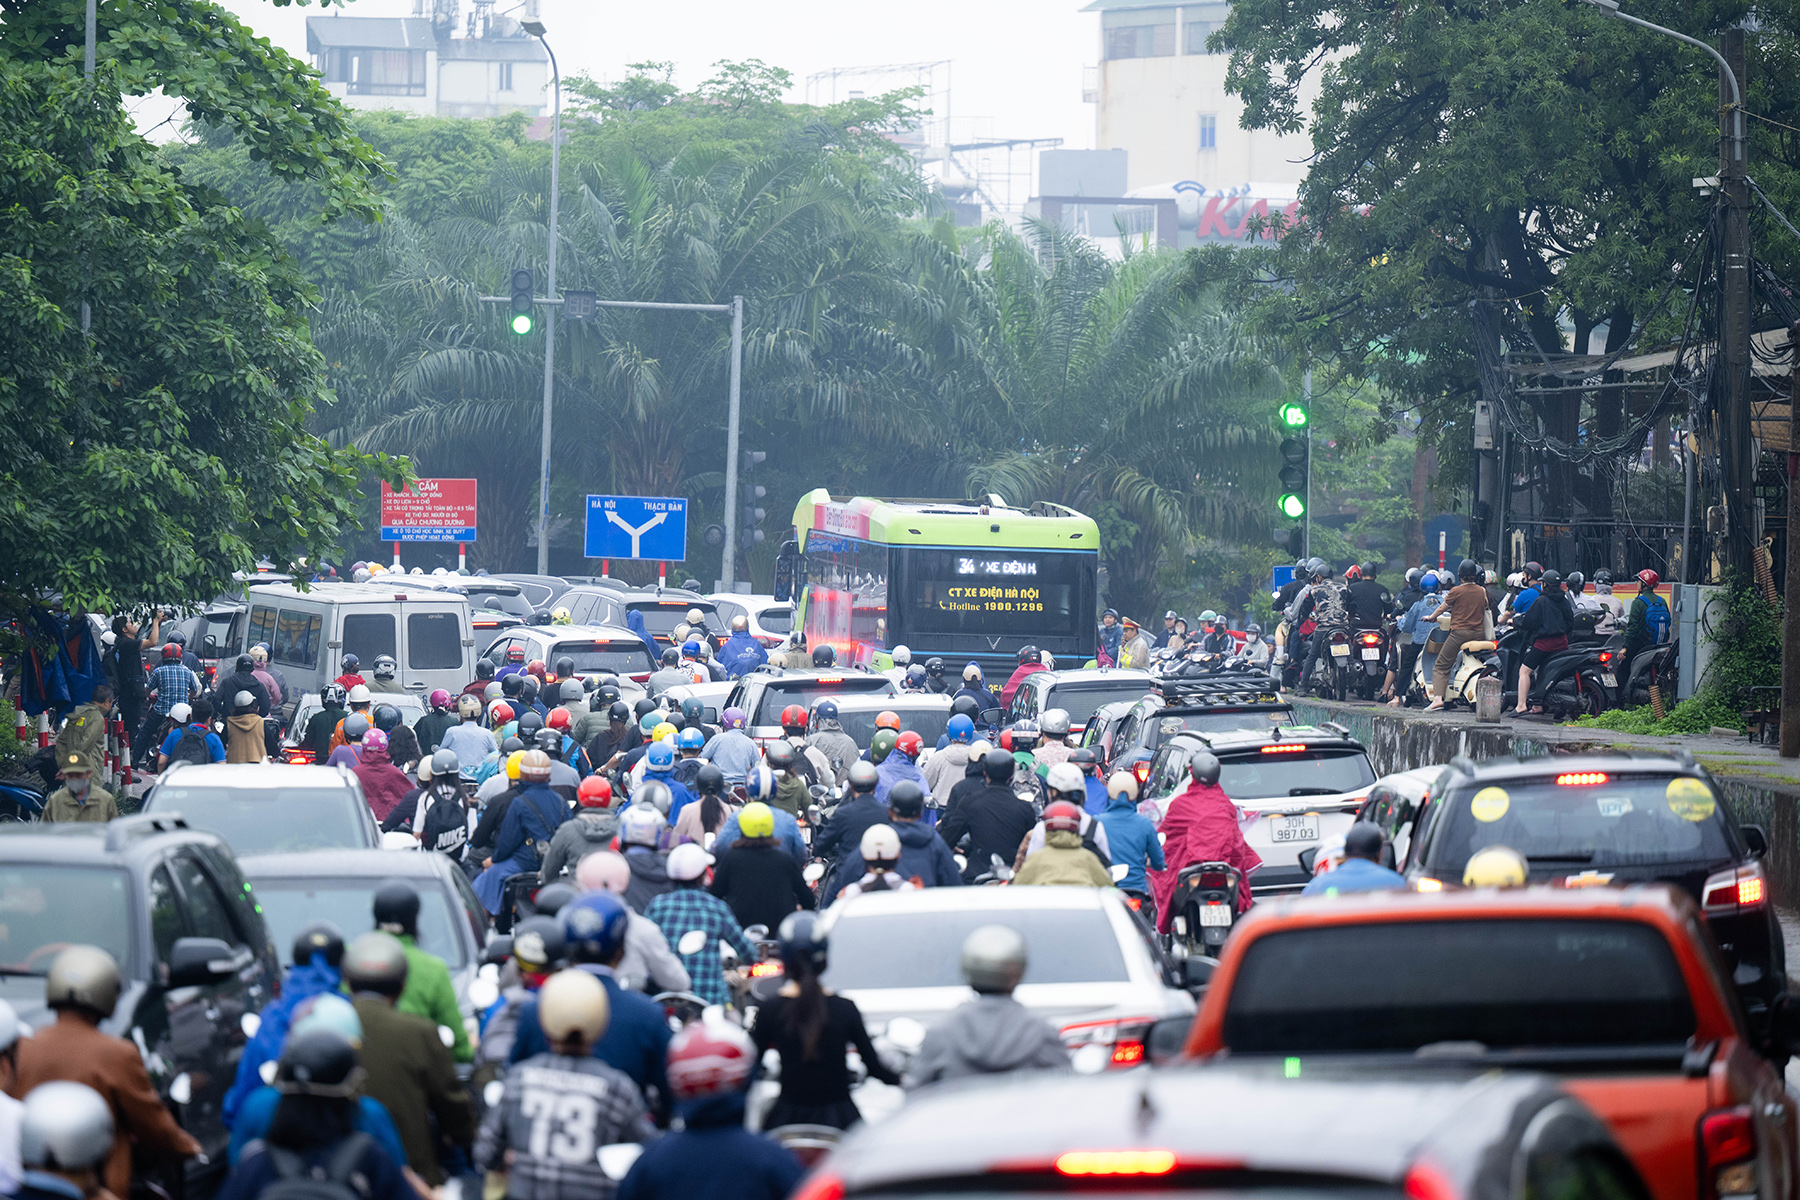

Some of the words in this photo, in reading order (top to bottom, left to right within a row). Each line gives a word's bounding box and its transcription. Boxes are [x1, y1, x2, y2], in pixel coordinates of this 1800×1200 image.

[419, 479, 438, 491] CẤM
[591, 498, 601, 508] HÀ
[604, 499, 616, 510] NỘI
[643, 502, 666, 512] THẠCH
[405, 517, 417, 526] CẦU
[419, 518, 443, 526] CHƯƠNG
[444, 518, 465, 526] DƯƠNG
[958, 558, 975, 574] 34
[948, 587, 963, 598] CT
[964, 587, 977, 598] XE
[1005, 586, 1018, 598] HÀ
[949, 602, 980, 611] Hotline
[984, 602, 1043, 612] 1900.1296
[1285, 818, 1305, 828] 30H
[437, 825, 467, 848] NIKE
[1277, 829, 1314, 840] 987.03
[522, 1089, 598, 1163] 73
